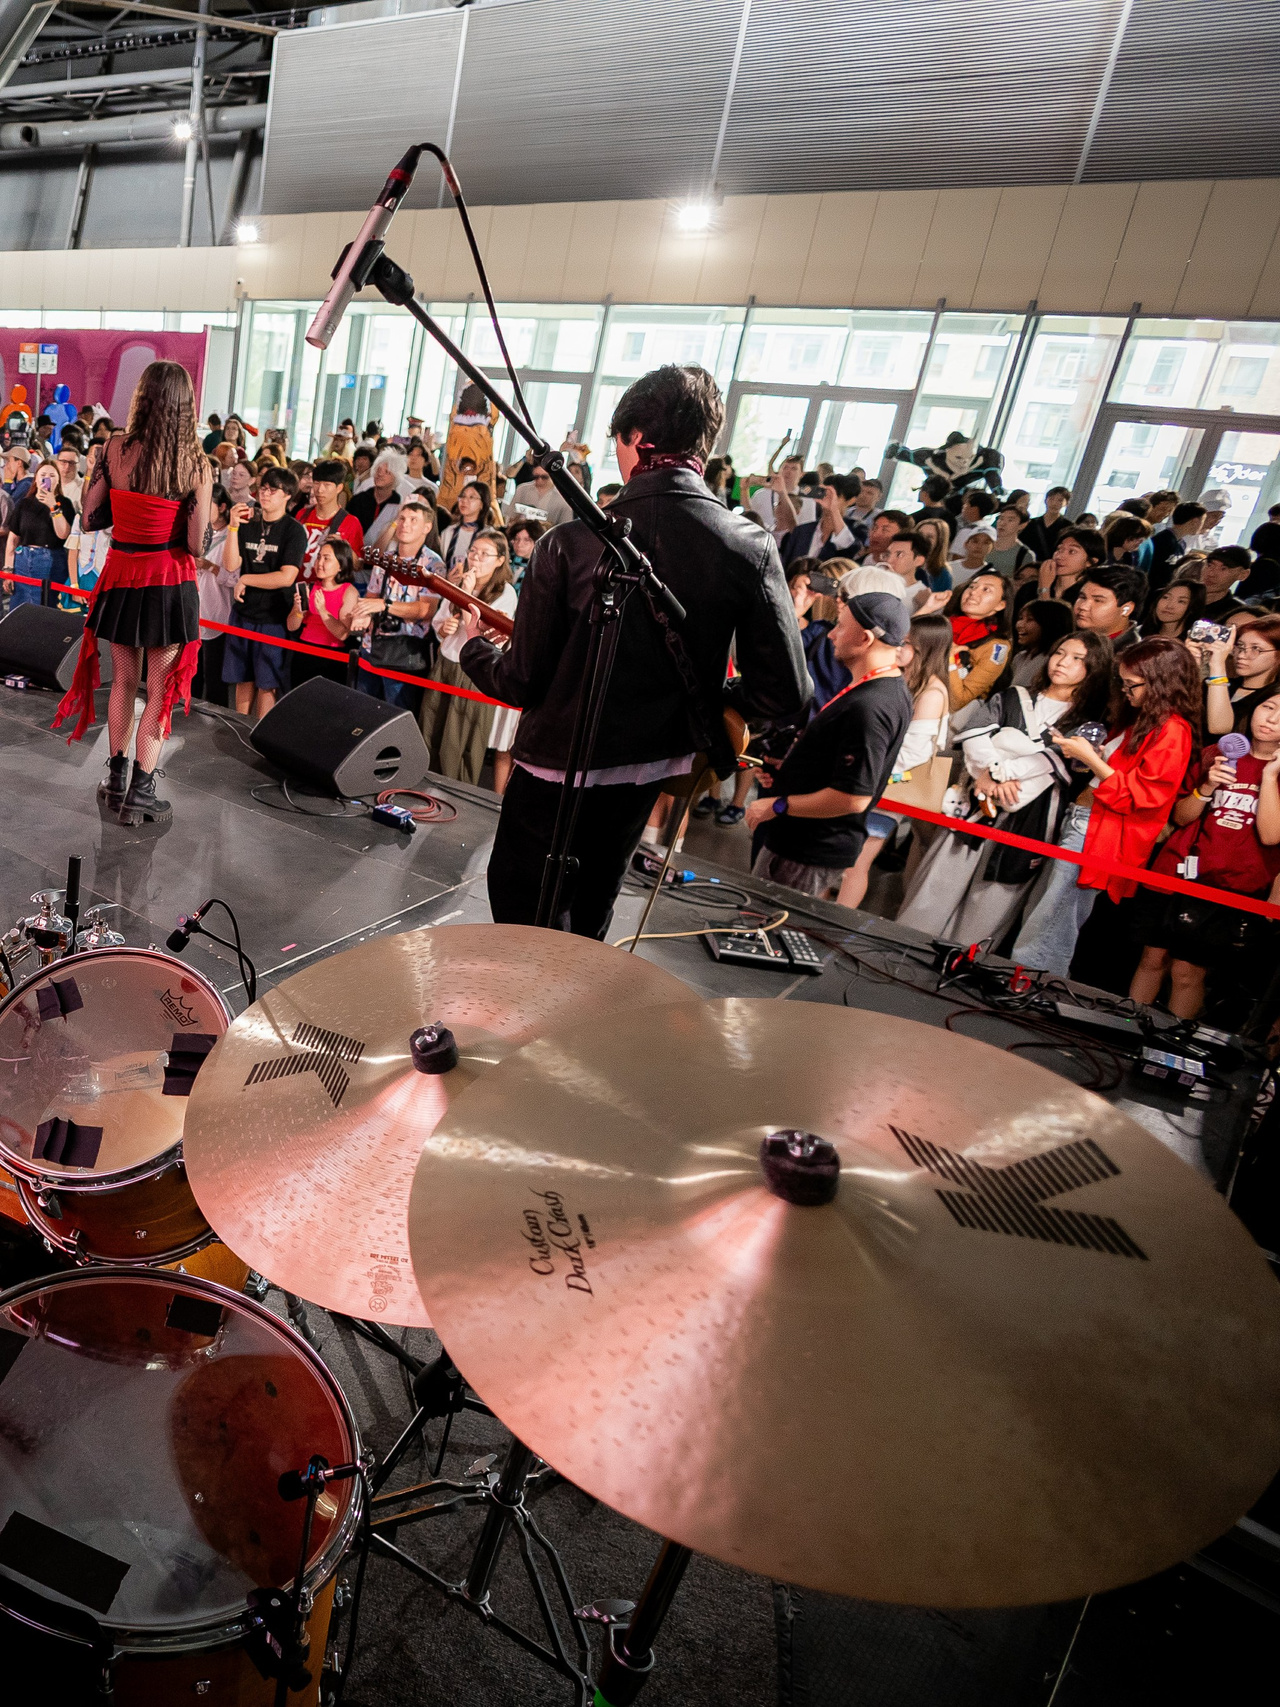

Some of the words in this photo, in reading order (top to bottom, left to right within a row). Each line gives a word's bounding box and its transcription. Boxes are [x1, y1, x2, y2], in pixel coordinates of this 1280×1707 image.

[164, 997, 189, 1024] REMO
[528, 1186, 573, 1238] Crash
[887, 1123, 1151, 1261] K
[520, 1209, 556, 1276] Custom
[548, 1235, 595, 1298] Dark
